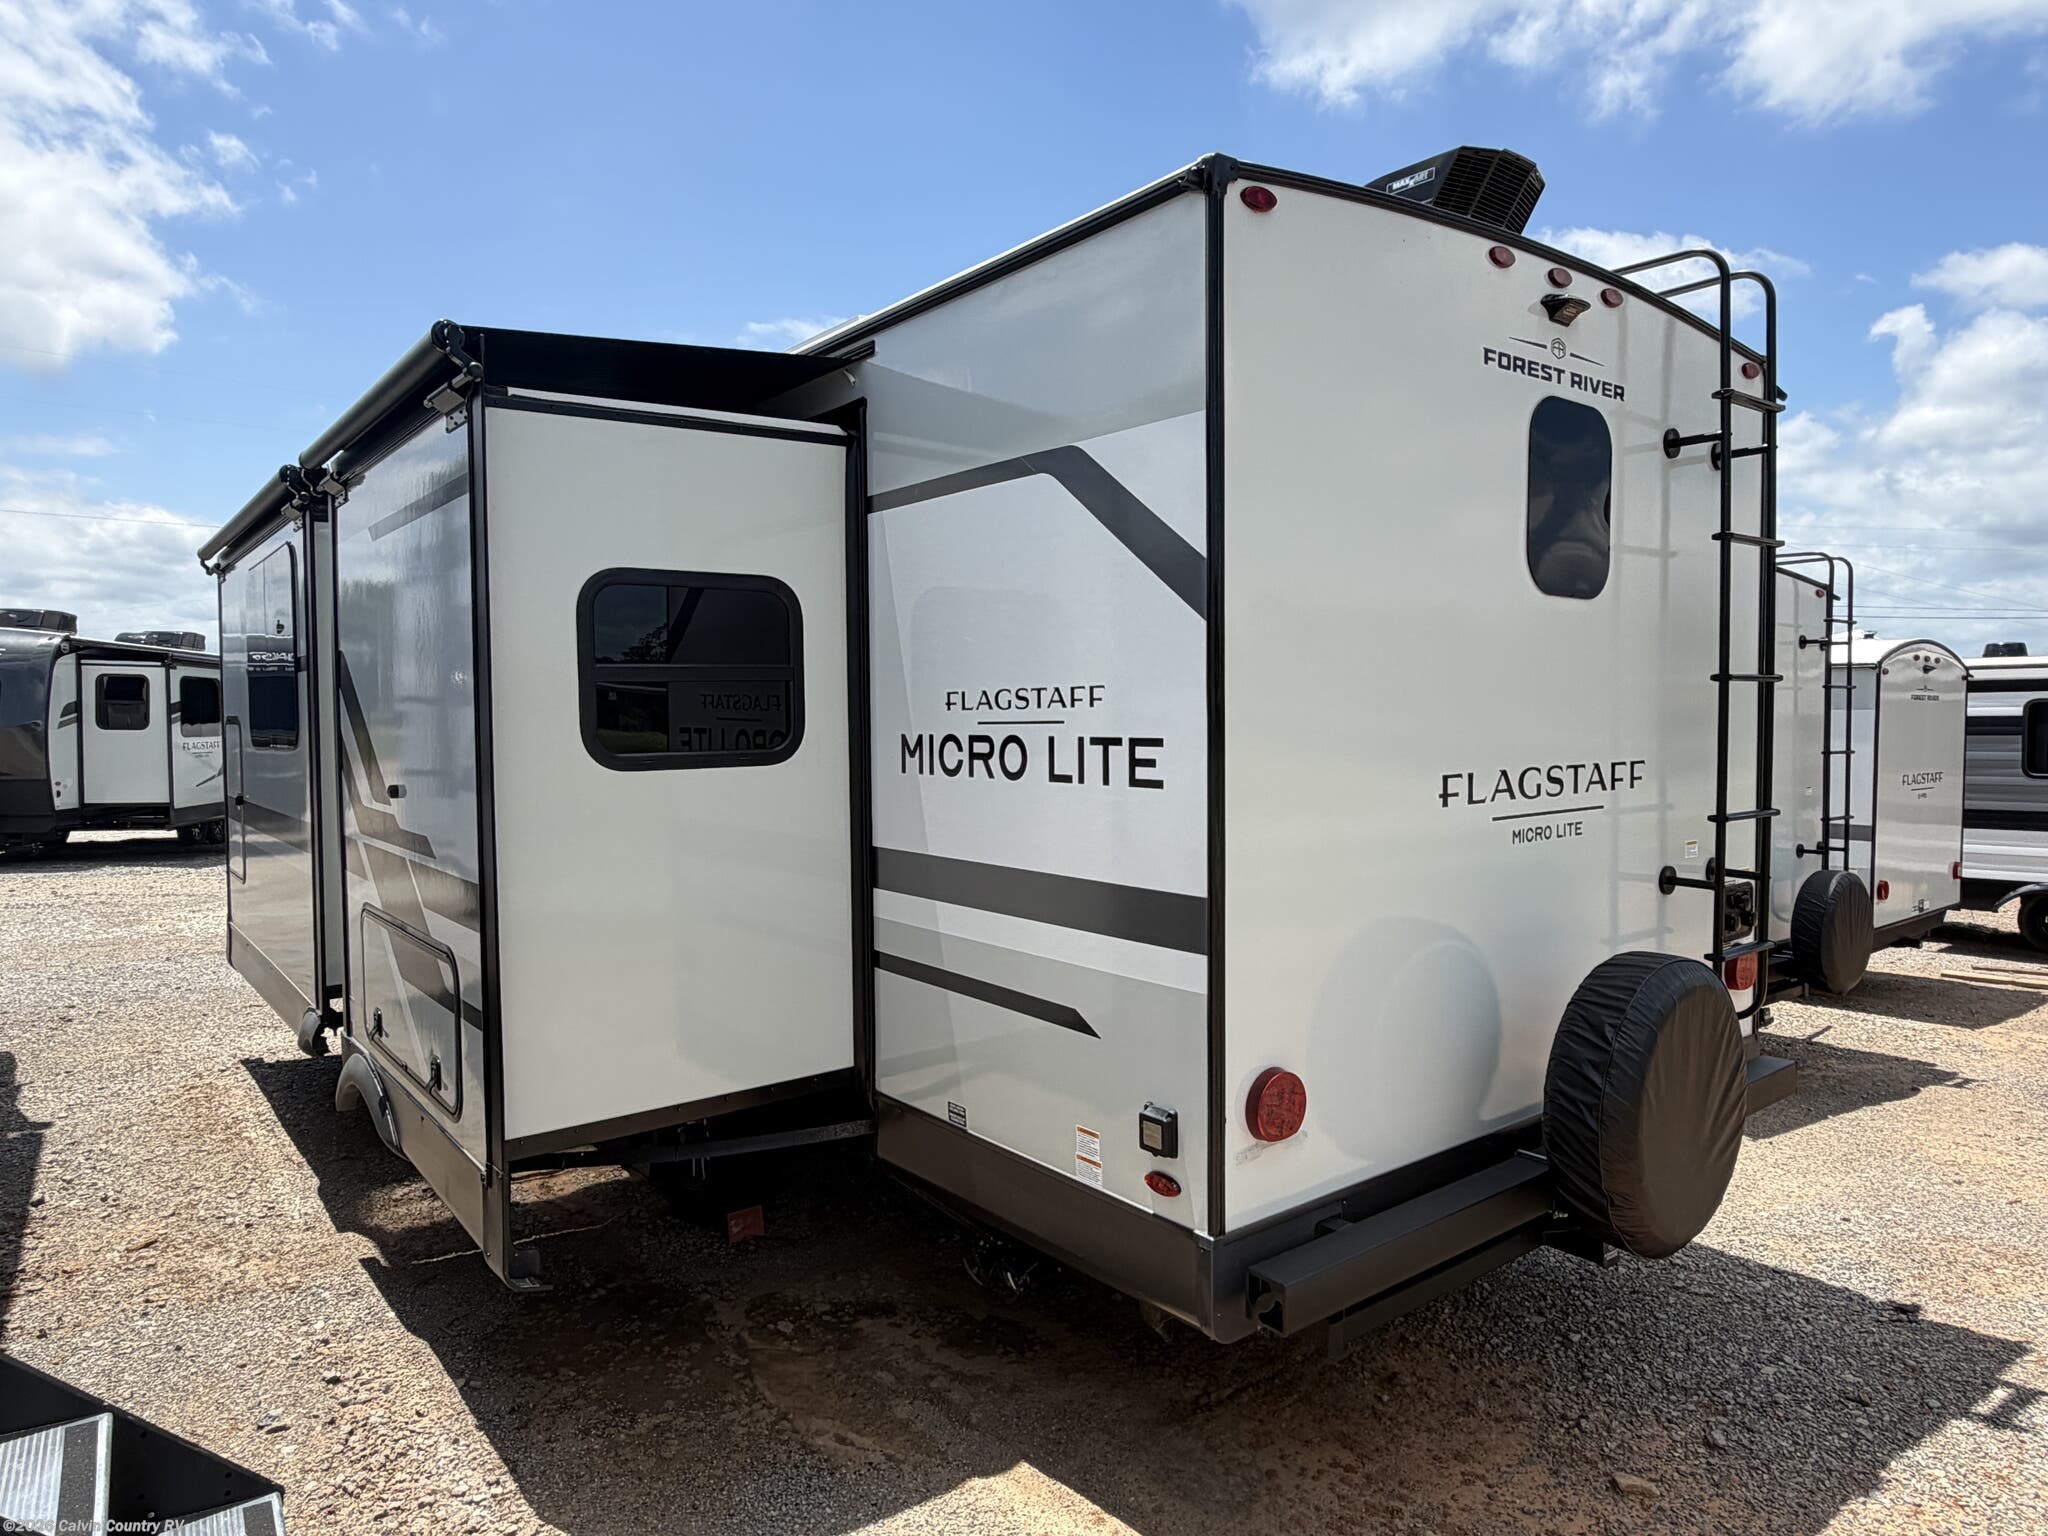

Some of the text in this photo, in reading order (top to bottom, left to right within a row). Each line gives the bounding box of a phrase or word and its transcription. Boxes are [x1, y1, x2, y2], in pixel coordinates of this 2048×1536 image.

[1483, 347, 1625, 402] FOREST RIVER
[945, 685, 1105, 711] FLAGSTAFF
[901, 733, 1164, 789] MICRO LITE
[1902, 772, 1943, 786] FLAGSTAFF
[1438, 760, 1646, 808] FLAGSTAFF
[1512, 821, 1583, 845] MICRO LITE
